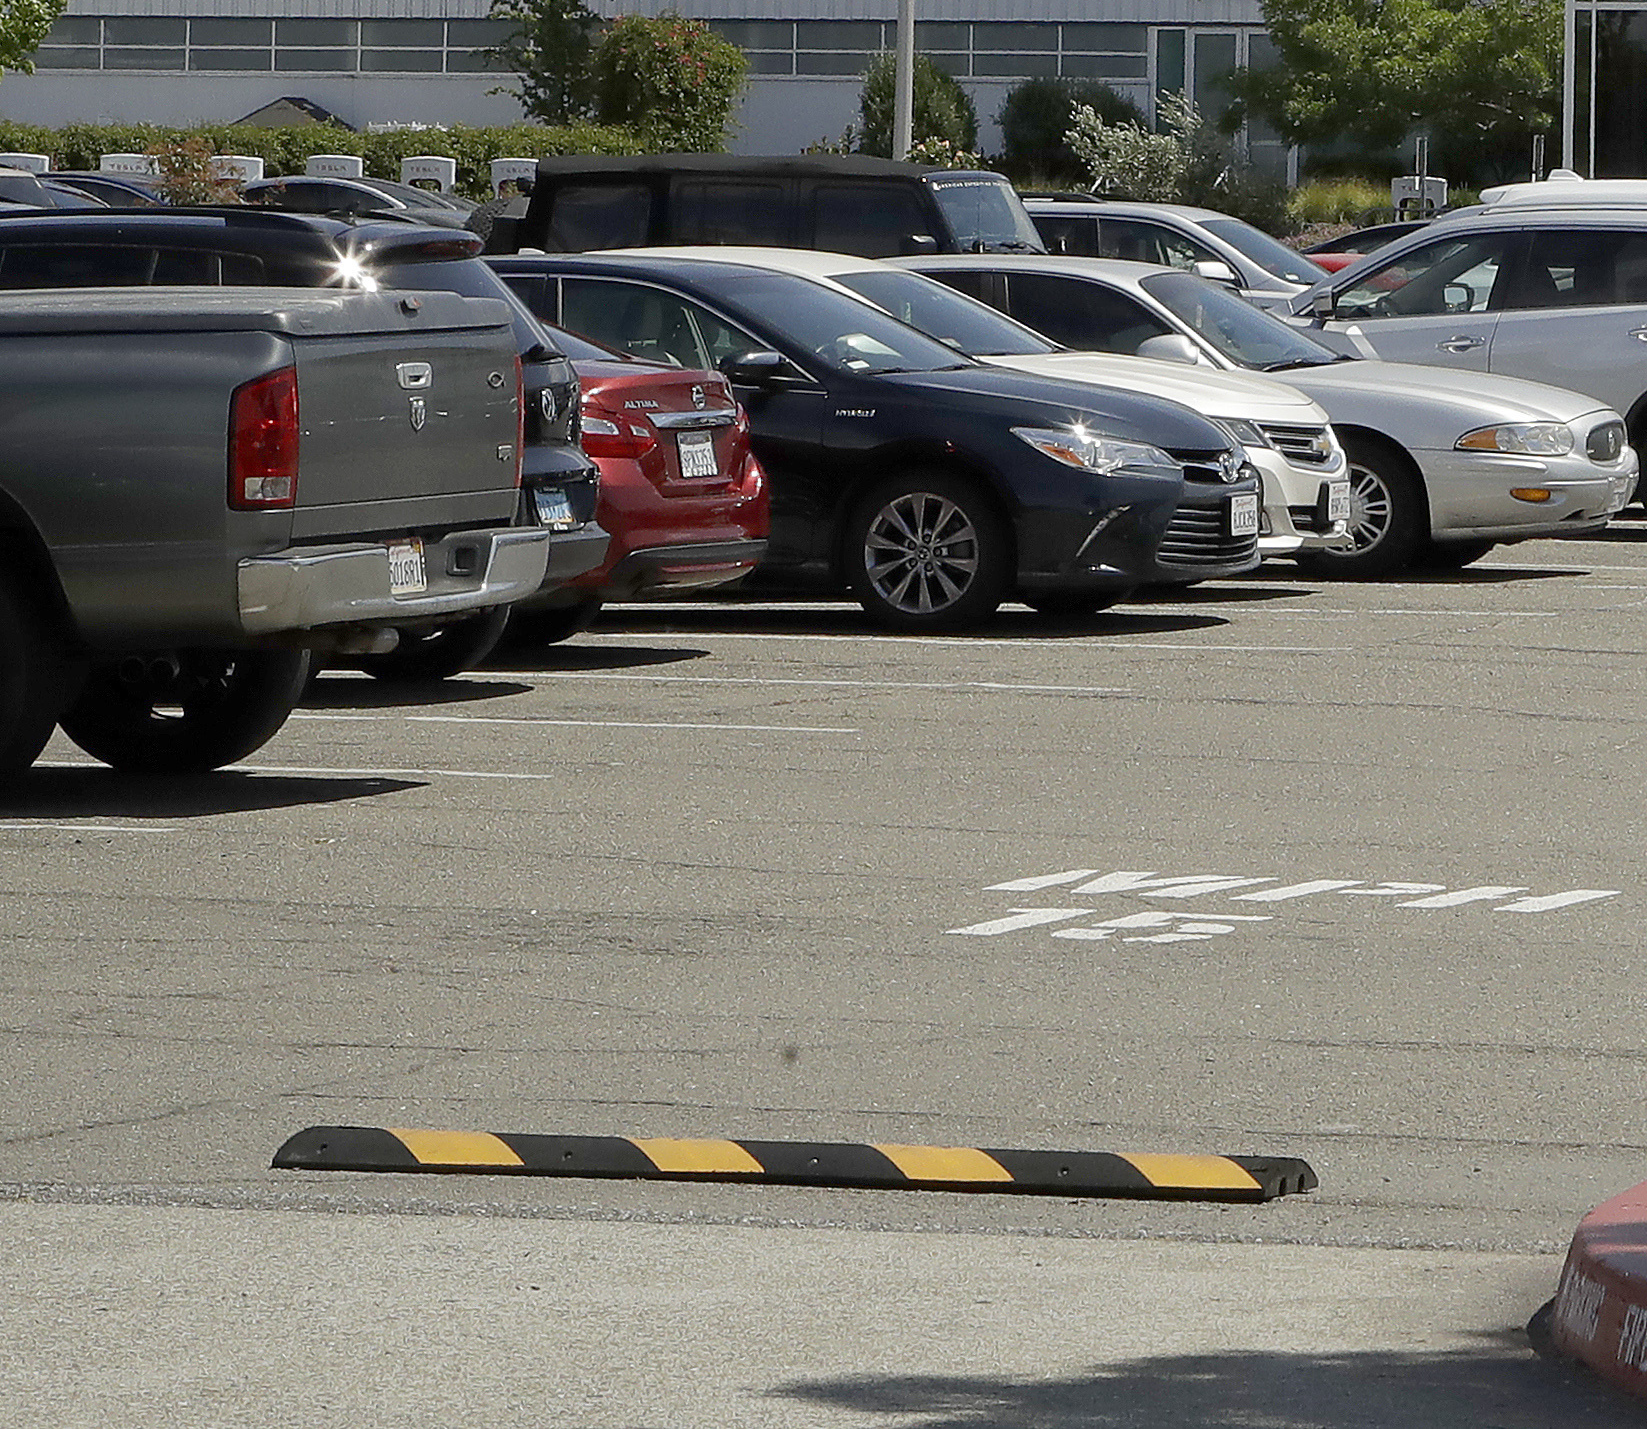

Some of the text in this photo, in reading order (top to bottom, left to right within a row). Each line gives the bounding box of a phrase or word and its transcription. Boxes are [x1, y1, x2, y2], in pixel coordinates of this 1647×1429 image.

[624, 399, 659, 409] ALTIMA
[981, 868, 1621, 914] MPH
[943, 907, 1274, 944] 15
